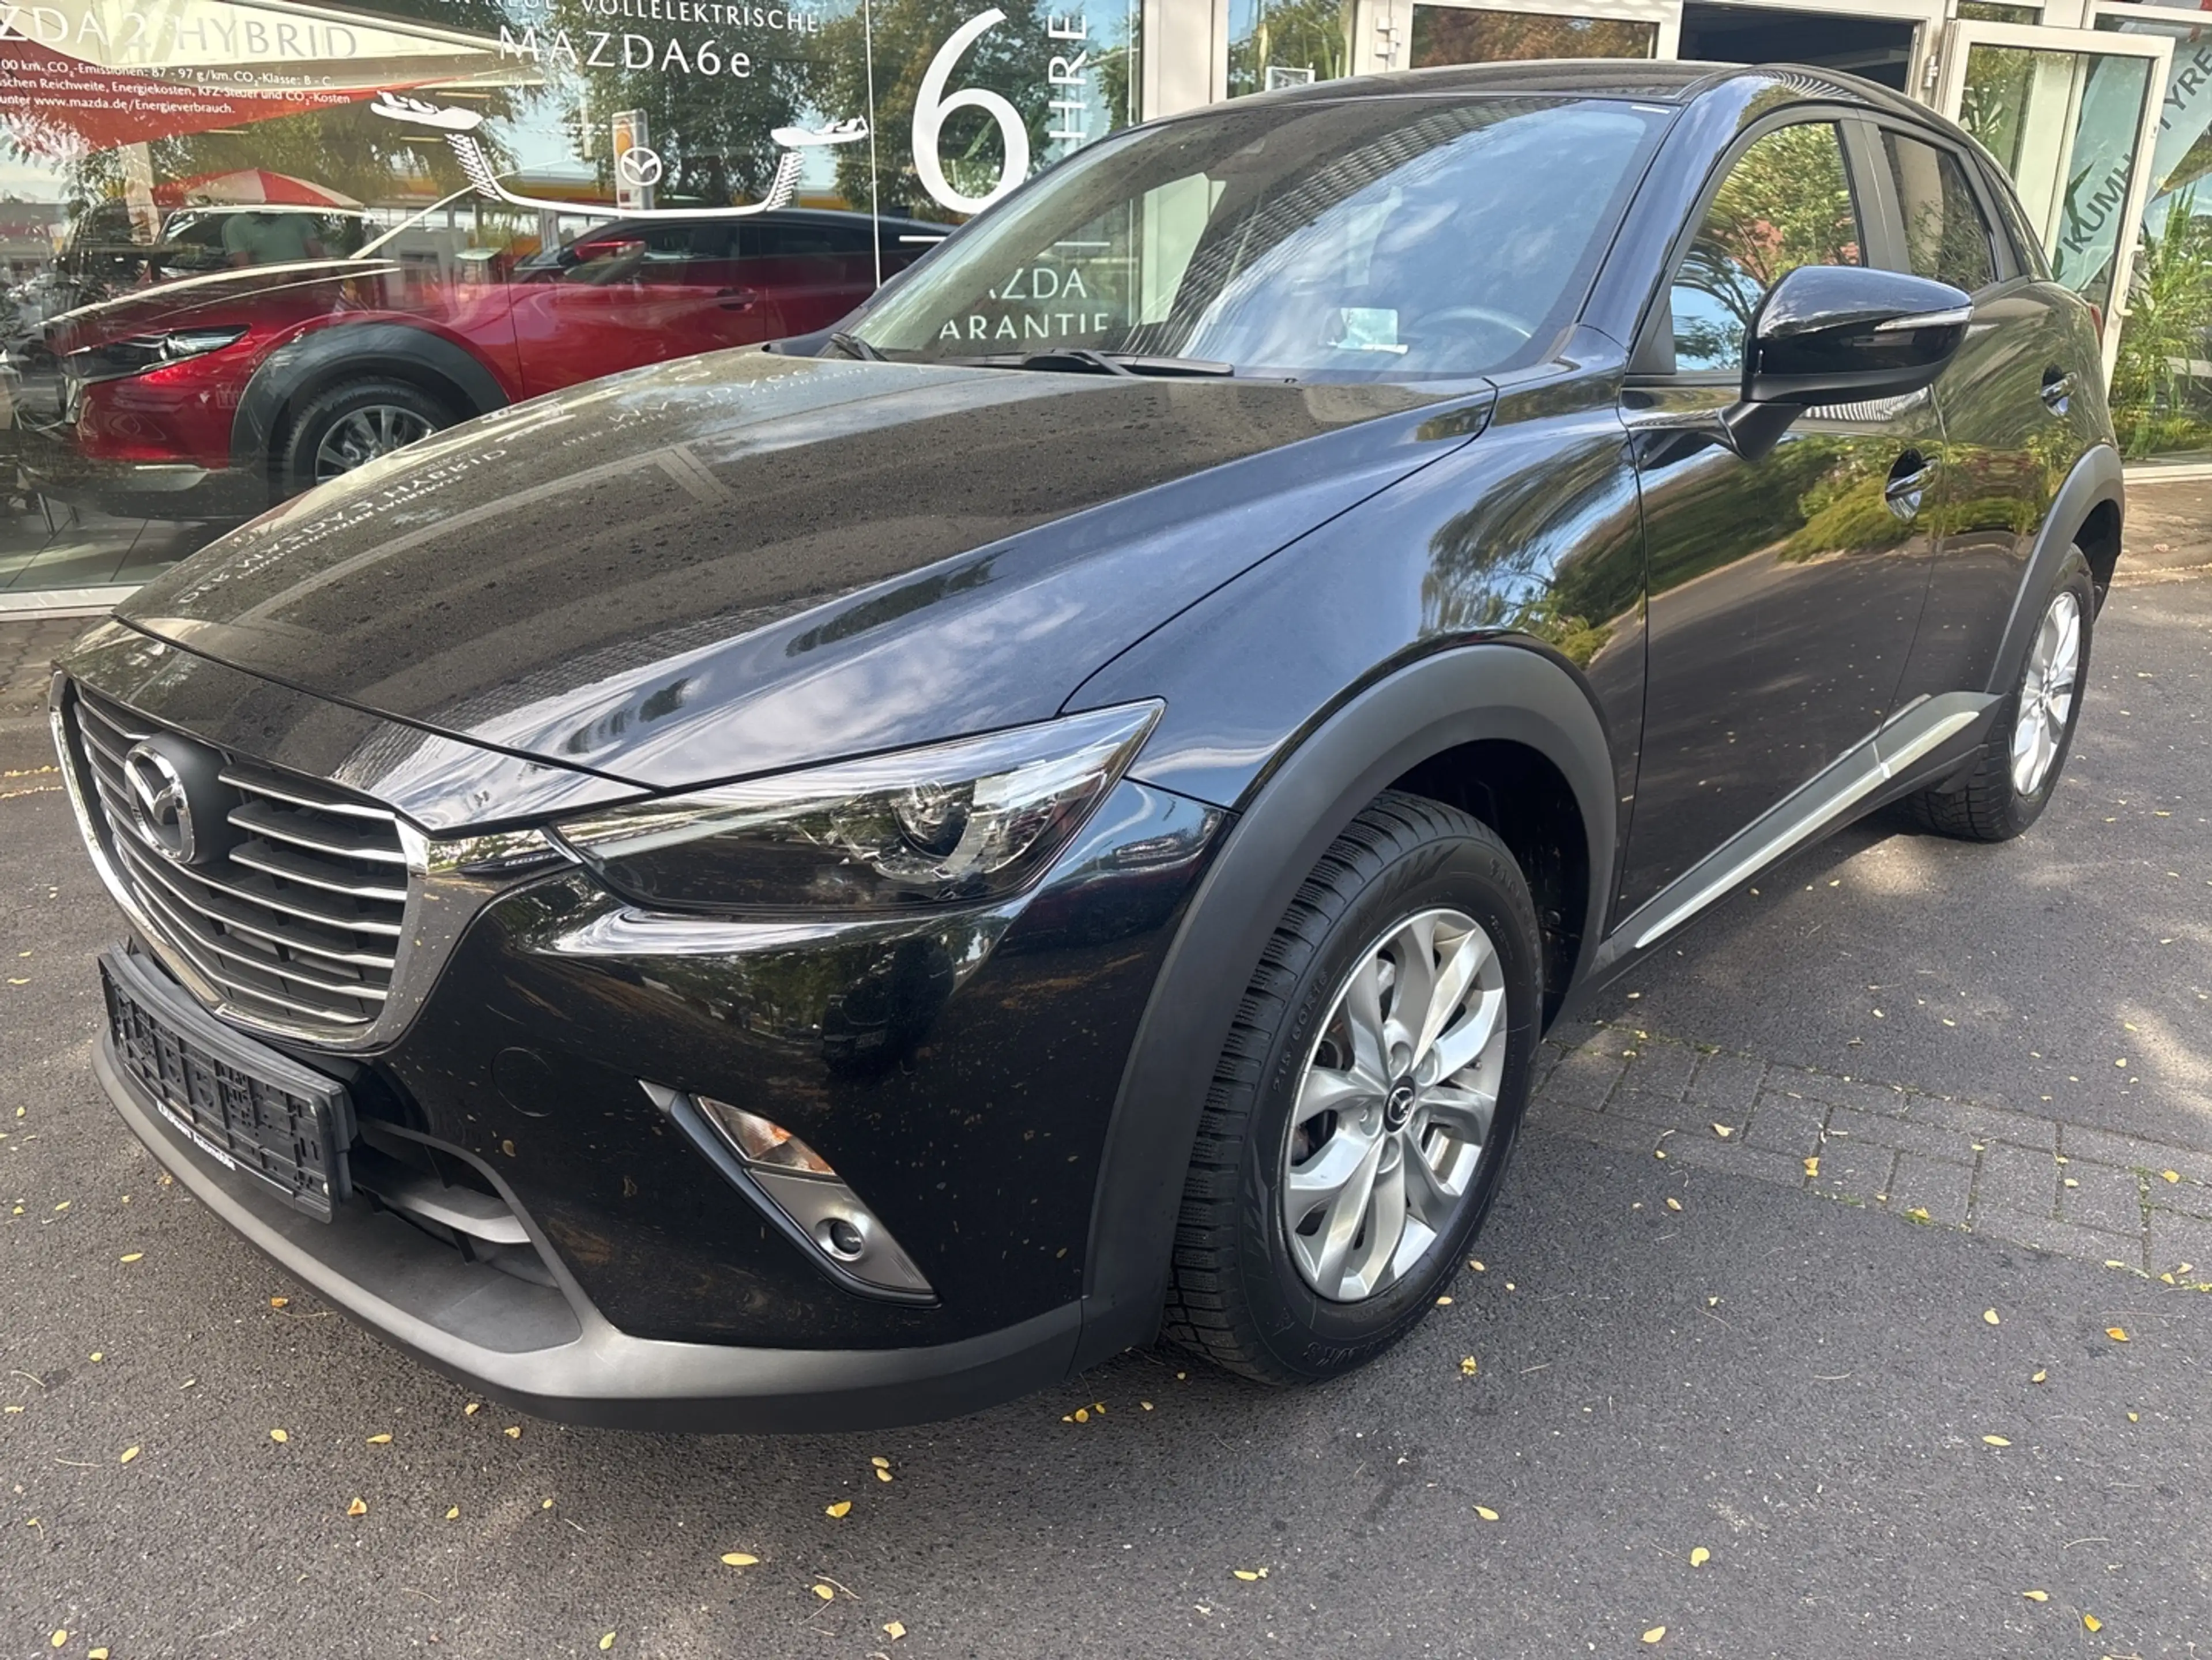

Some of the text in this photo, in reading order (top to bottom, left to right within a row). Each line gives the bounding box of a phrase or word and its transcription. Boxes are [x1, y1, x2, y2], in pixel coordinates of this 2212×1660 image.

[582, 0, 818, 32] VOLLELEKTRISCHE
[176, 15, 356, 57] HYBRID
[500, 25, 750, 78] MAZDA6e
[112, 82, 196, 97] Energiekosten,
[261, 90, 282, 100] und
[152, 67, 166, 77] 87
[178, 69, 193, 79] 97
[304, 76, 311, 85] B
[1047, 14, 1087, 139] HRE
[911, 7, 1030, 214] 6
[2062, 153, 2131, 254] KUMH
[989, 268, 1087, 299] ZDA
[939, 314, 1109, 339] ARANTIE
